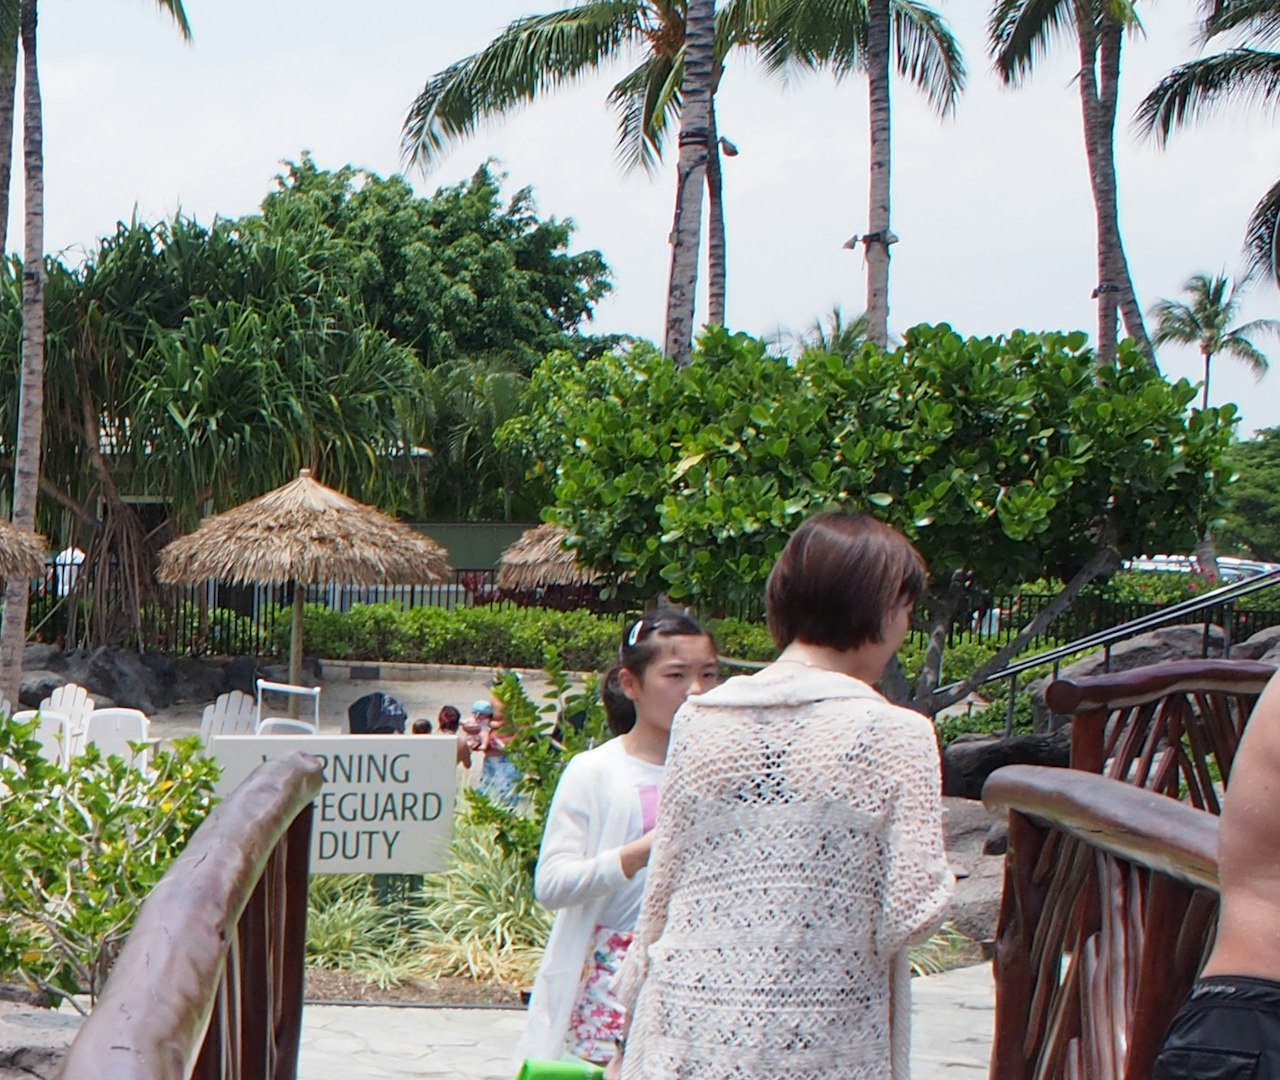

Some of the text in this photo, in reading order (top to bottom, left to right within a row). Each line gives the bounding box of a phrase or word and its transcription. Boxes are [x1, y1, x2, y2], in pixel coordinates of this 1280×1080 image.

[262, 753, 410, 784] RNING
[312, 791, 443, 822] EGUARD
[318, 830, 401, 861] DUTY
